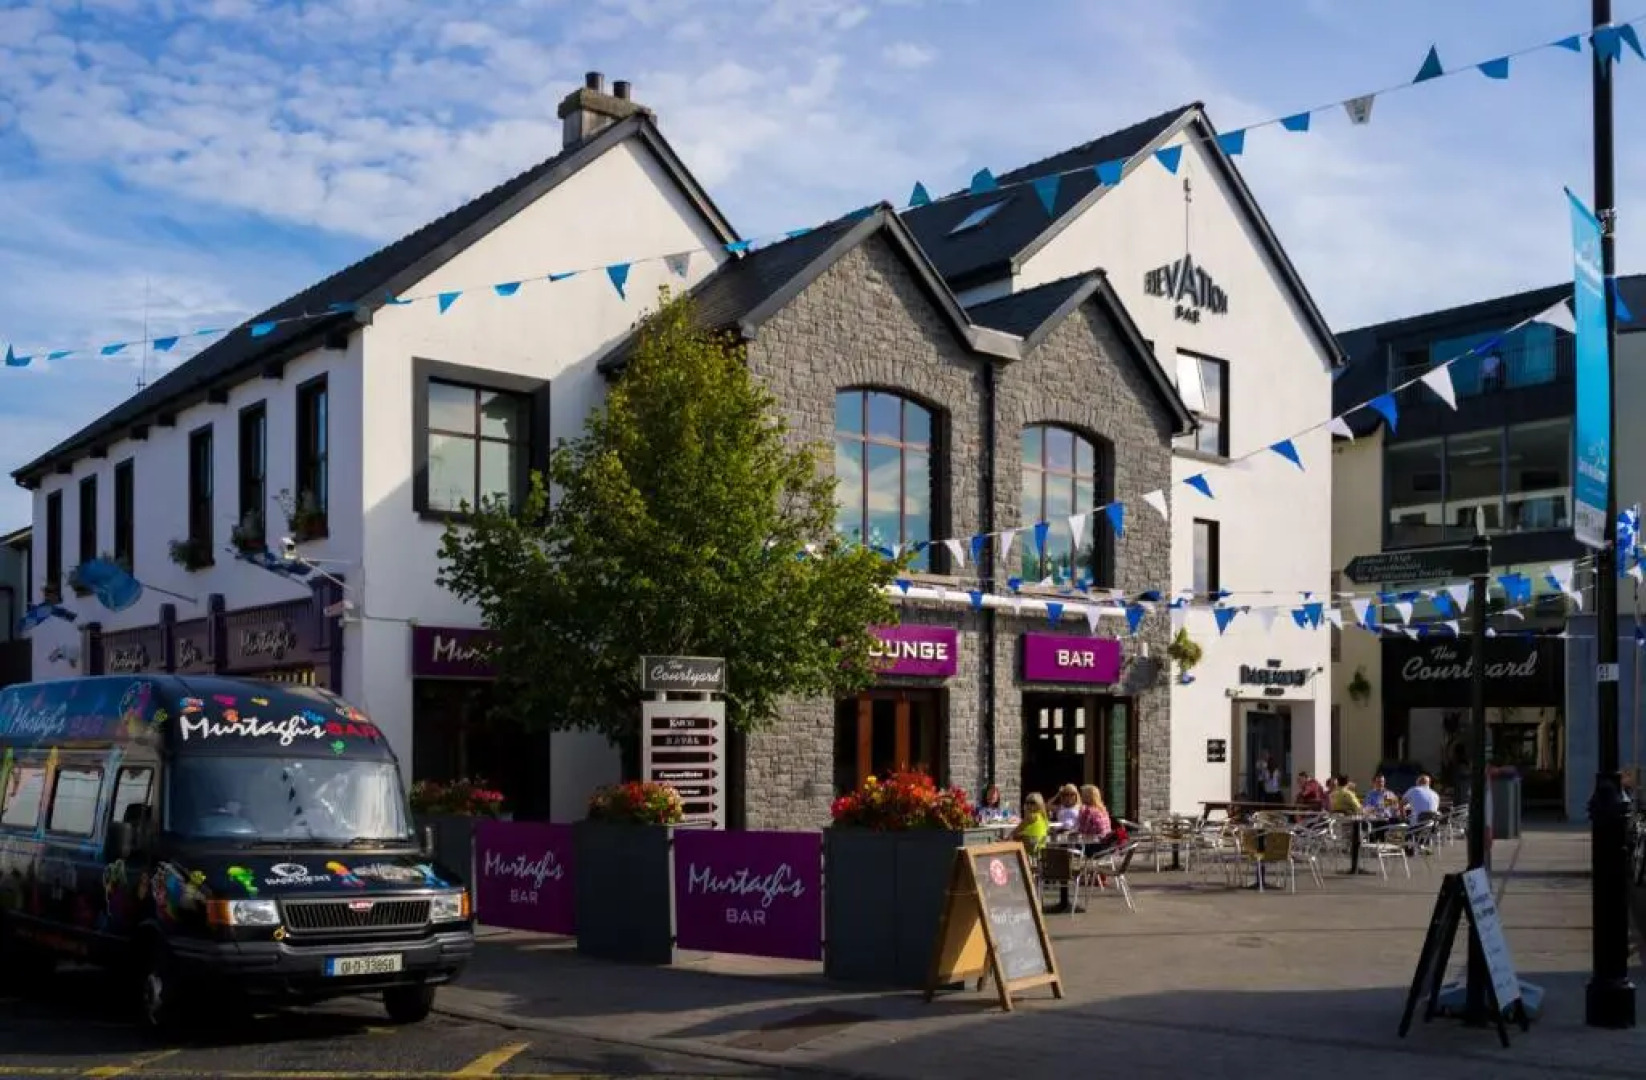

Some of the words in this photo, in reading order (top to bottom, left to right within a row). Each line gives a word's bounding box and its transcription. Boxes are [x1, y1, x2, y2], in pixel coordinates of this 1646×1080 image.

[868, 640, 949, 660] OUNGE
[1058, 649, 1095, 668] BAR
[1430, 646, 1458, 660] The
[651, 664, 721, 687] Courtyard
[1402, 650, 1538, 681] Courtard
[180, 714, 326, 746] Murtagh's
[485, 848, 563, 889] Murtagh's
[510, 888, 539, 904] BAR
[688, 862, 806, 909] Murtagh's
[726, 908, 767, 925] BAR
